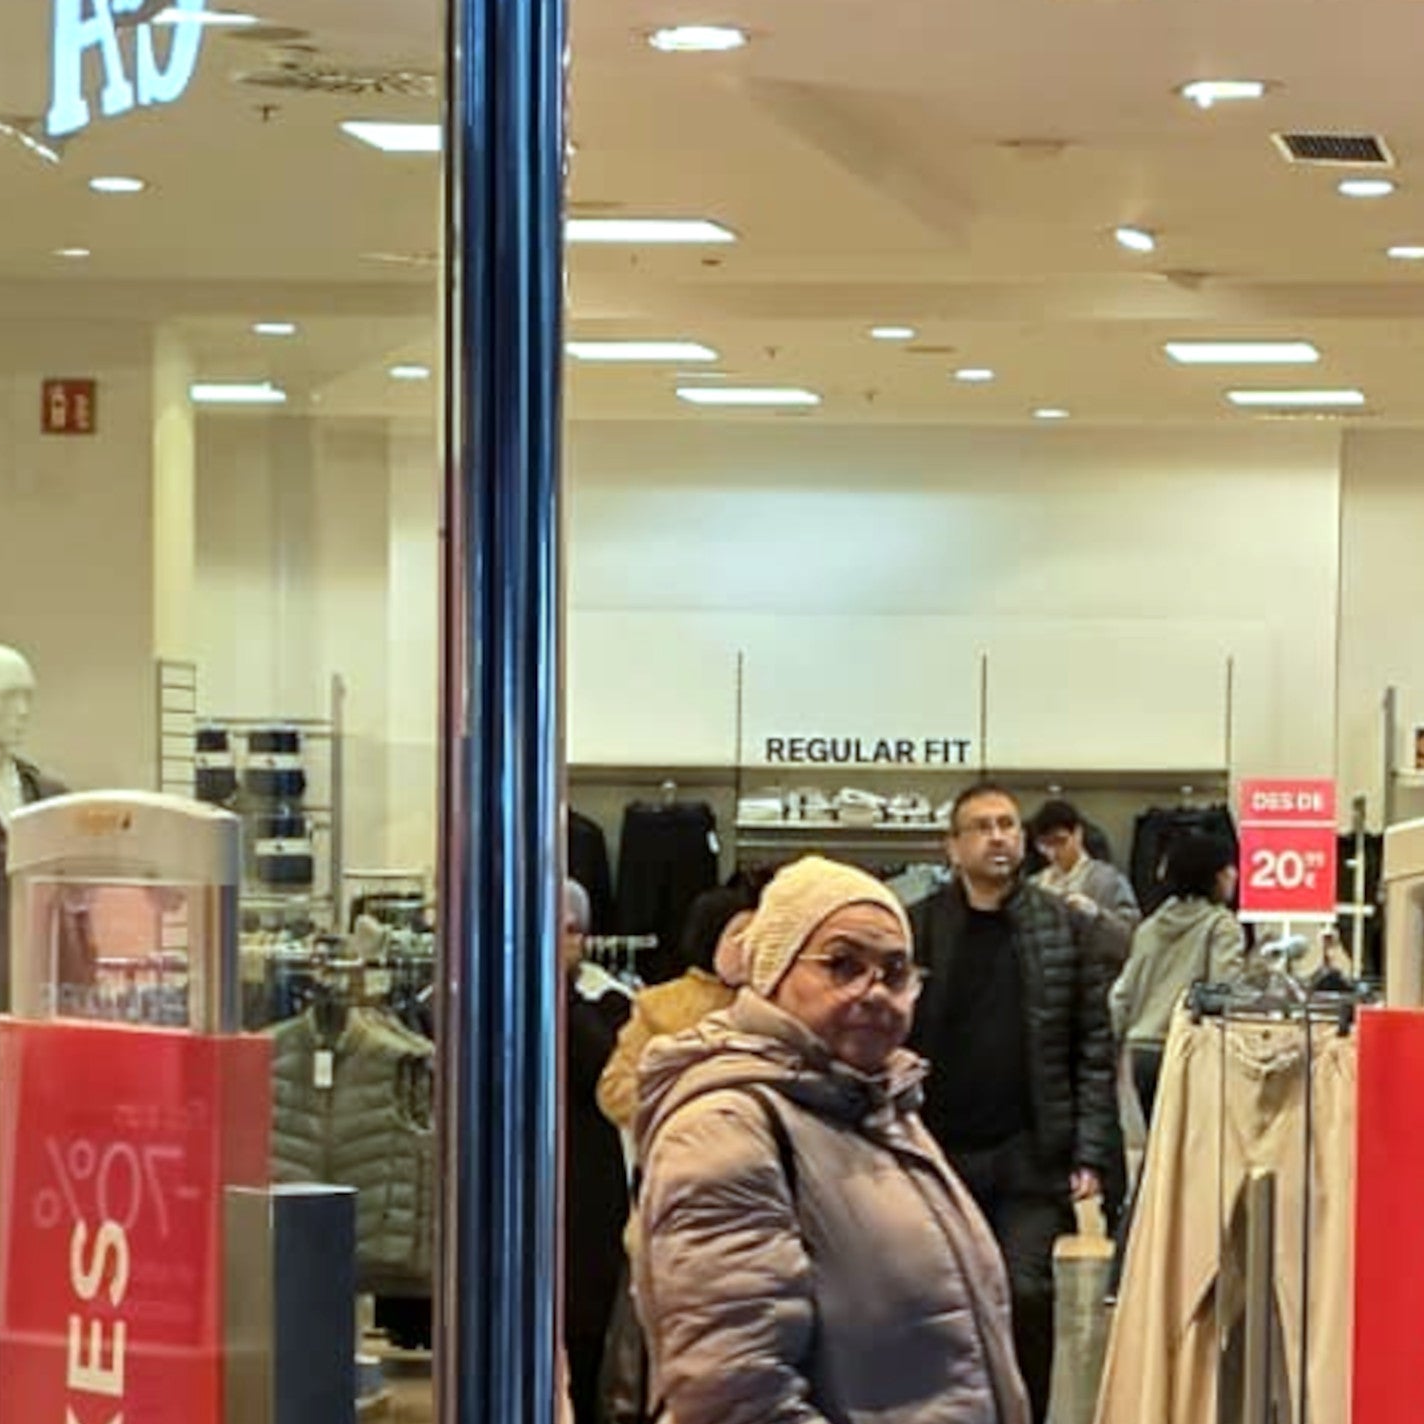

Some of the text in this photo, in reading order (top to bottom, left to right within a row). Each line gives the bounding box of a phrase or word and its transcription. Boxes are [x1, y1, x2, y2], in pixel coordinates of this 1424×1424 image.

[764, 737, 971, 763] REGULAR FIT
[1250, 849, 1303, 889] 20
